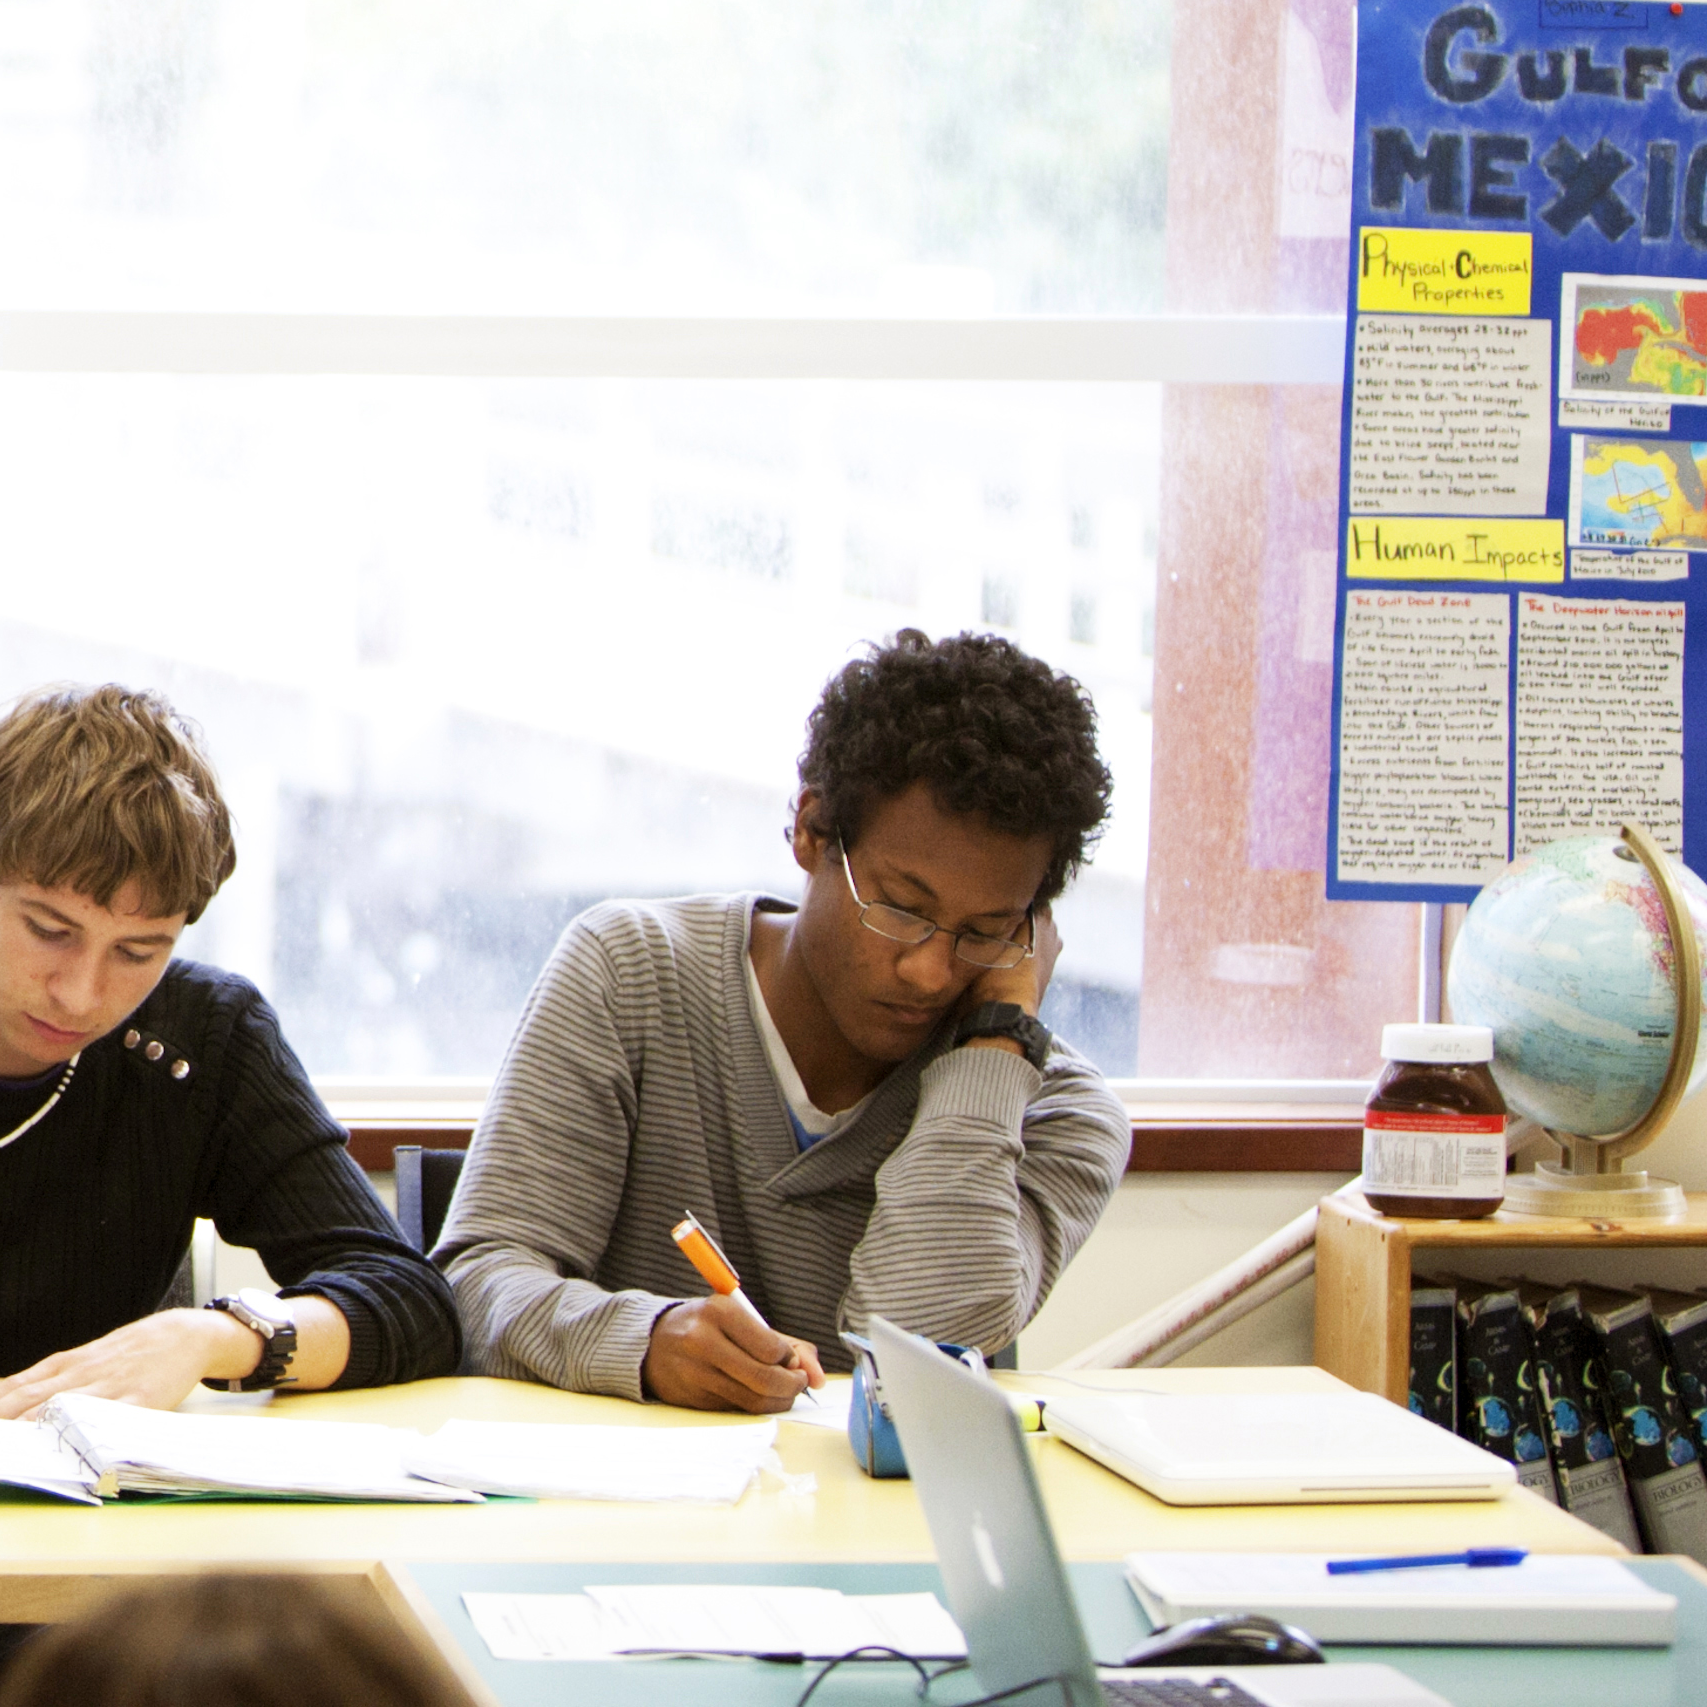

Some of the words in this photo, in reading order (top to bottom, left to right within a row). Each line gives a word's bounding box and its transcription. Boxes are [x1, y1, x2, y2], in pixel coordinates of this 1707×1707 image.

[1423, 5, 1670, 104] GULF
[1413, 282, 1505, 301] Properties
[1352, 523, 1456, 562] Human
[1463, 533, 1564, 578] Impacts
[1571, 1467, 1621, 1496] BIOLOGY
[1652, 1473, 1704, 1501] BIOLOGY
